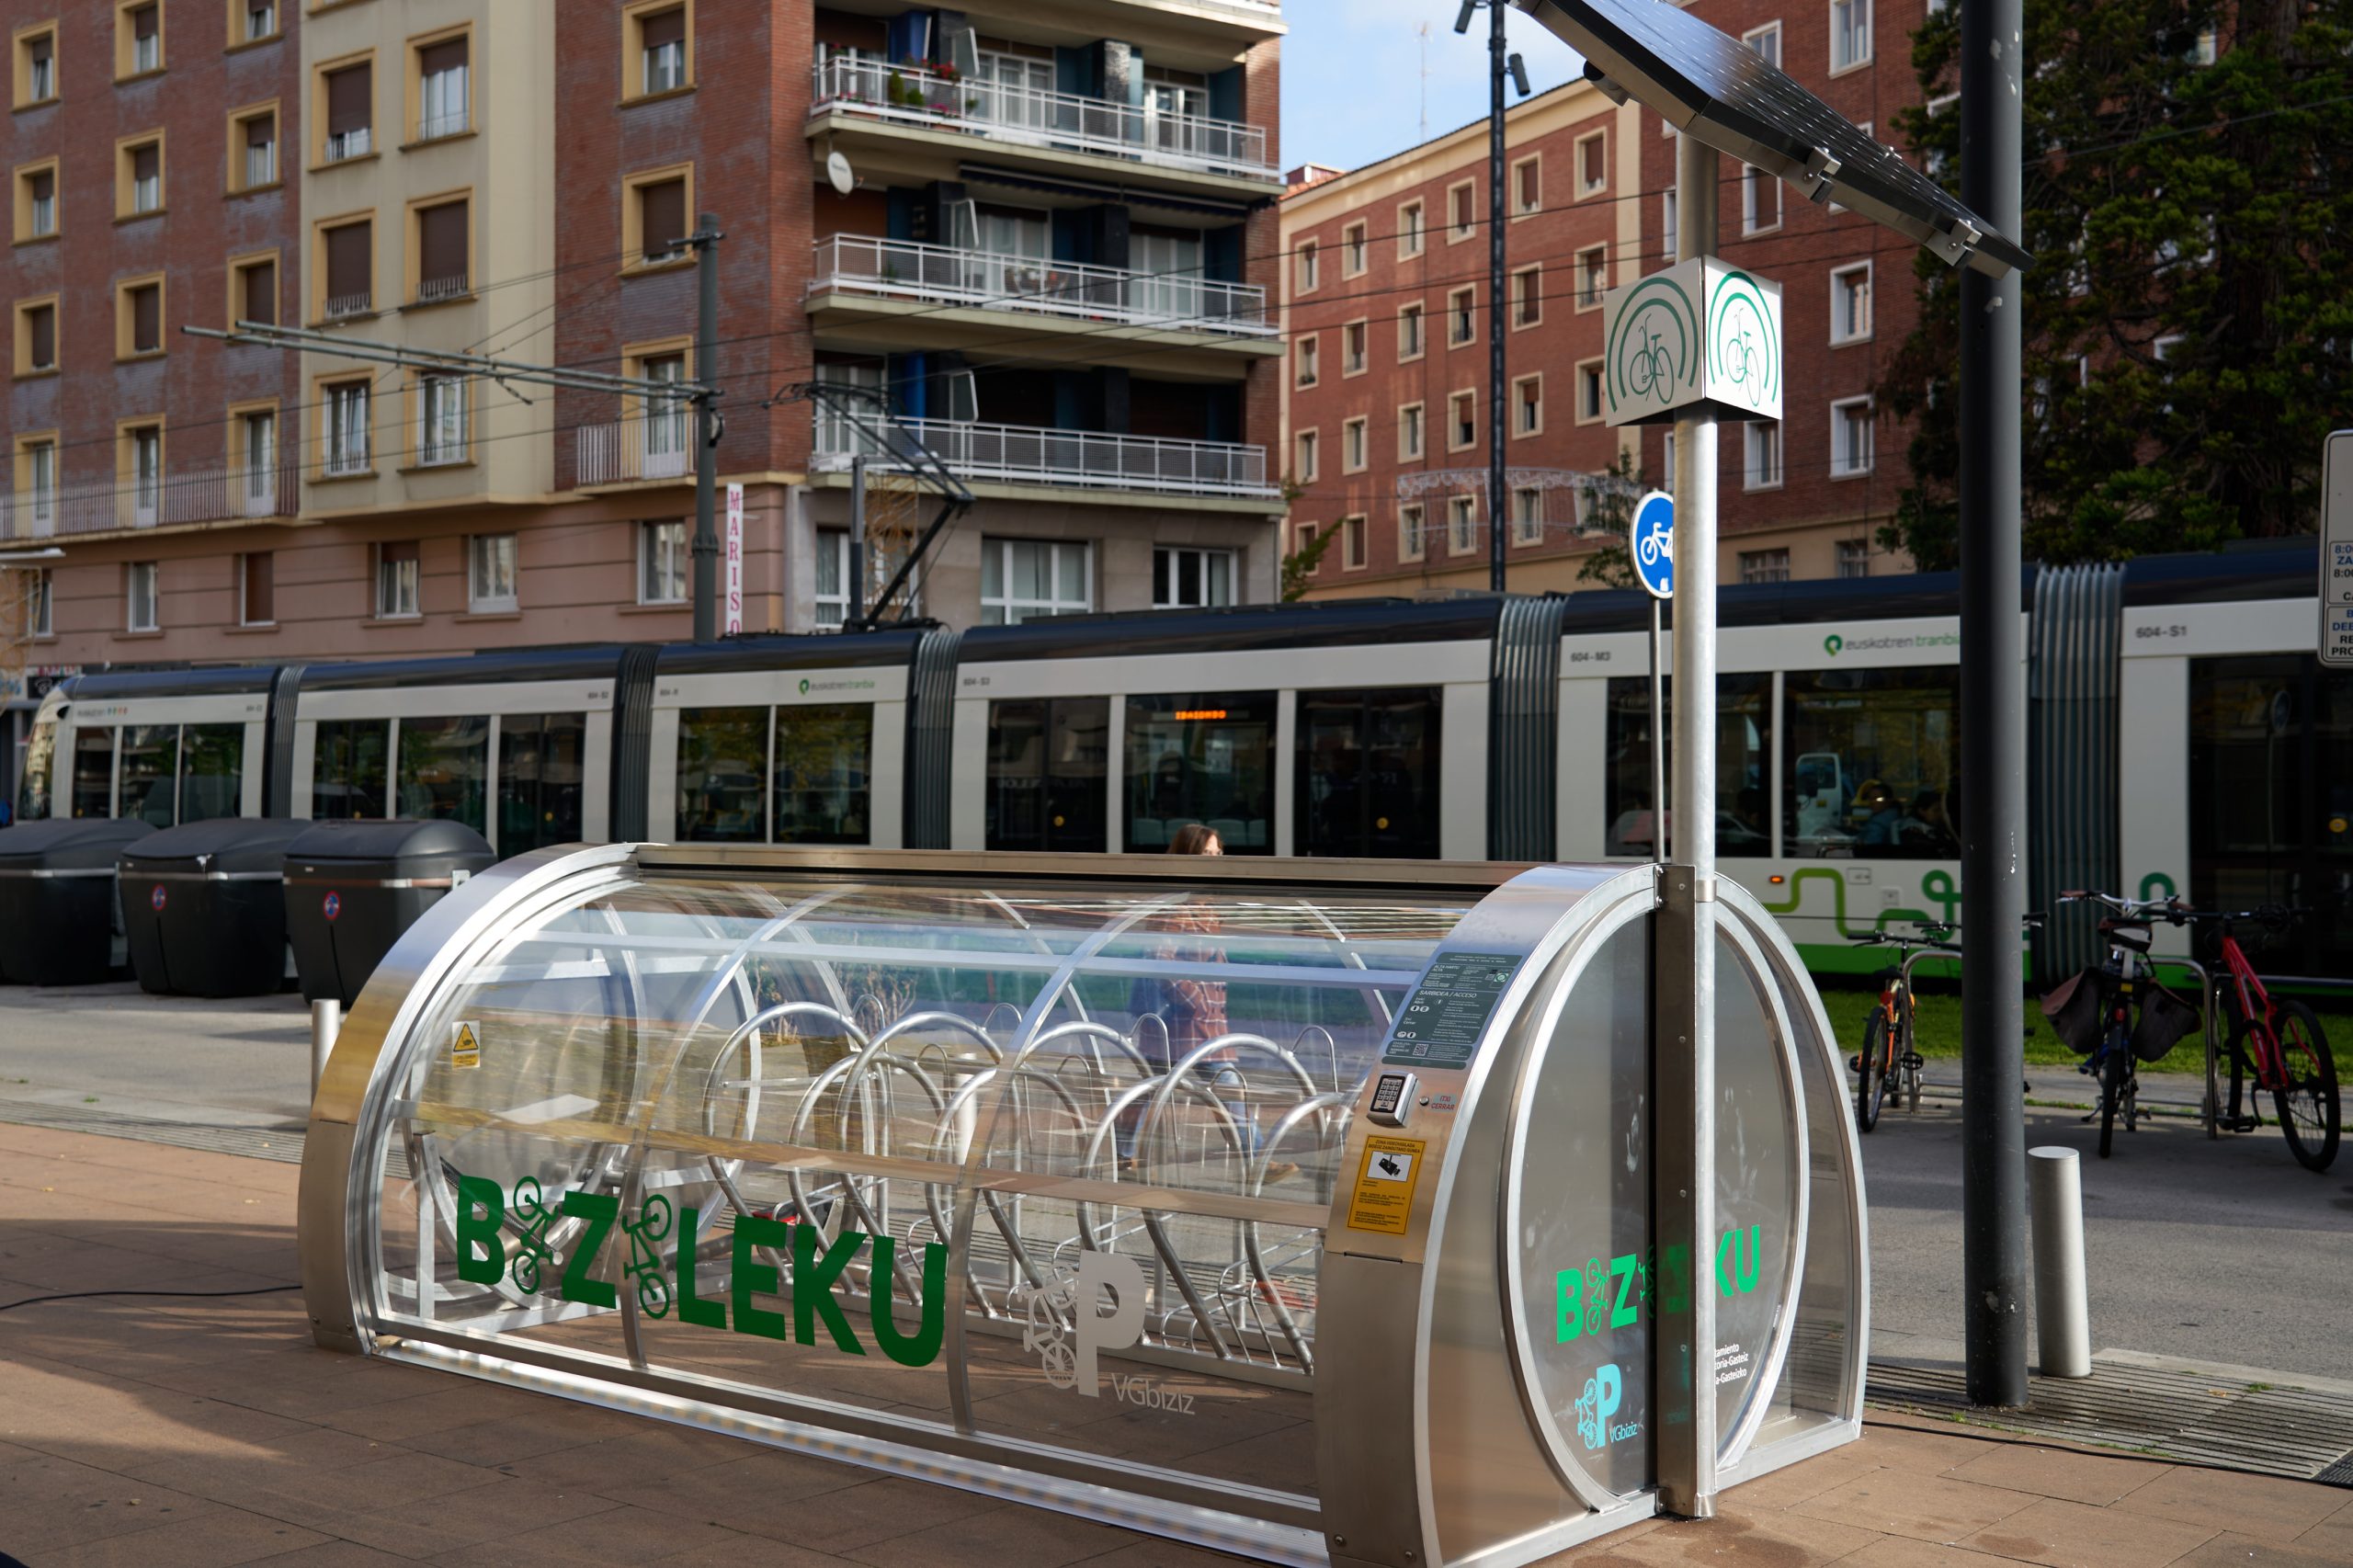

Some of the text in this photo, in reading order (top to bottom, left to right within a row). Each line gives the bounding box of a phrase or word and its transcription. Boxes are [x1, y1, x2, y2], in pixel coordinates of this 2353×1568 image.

[2334, 544, 2353, 554] 8:0
[2336, 556, 2353, 565] ZA
[1845, 631, 1960, 651] euskotren tranbi
[1714, 1343, 1740, 1358] tamiento
[1714, 1351, 1749, 1369] toria-Gasteiz
[1111, 1372, 1196, 1415] VGbiziz
